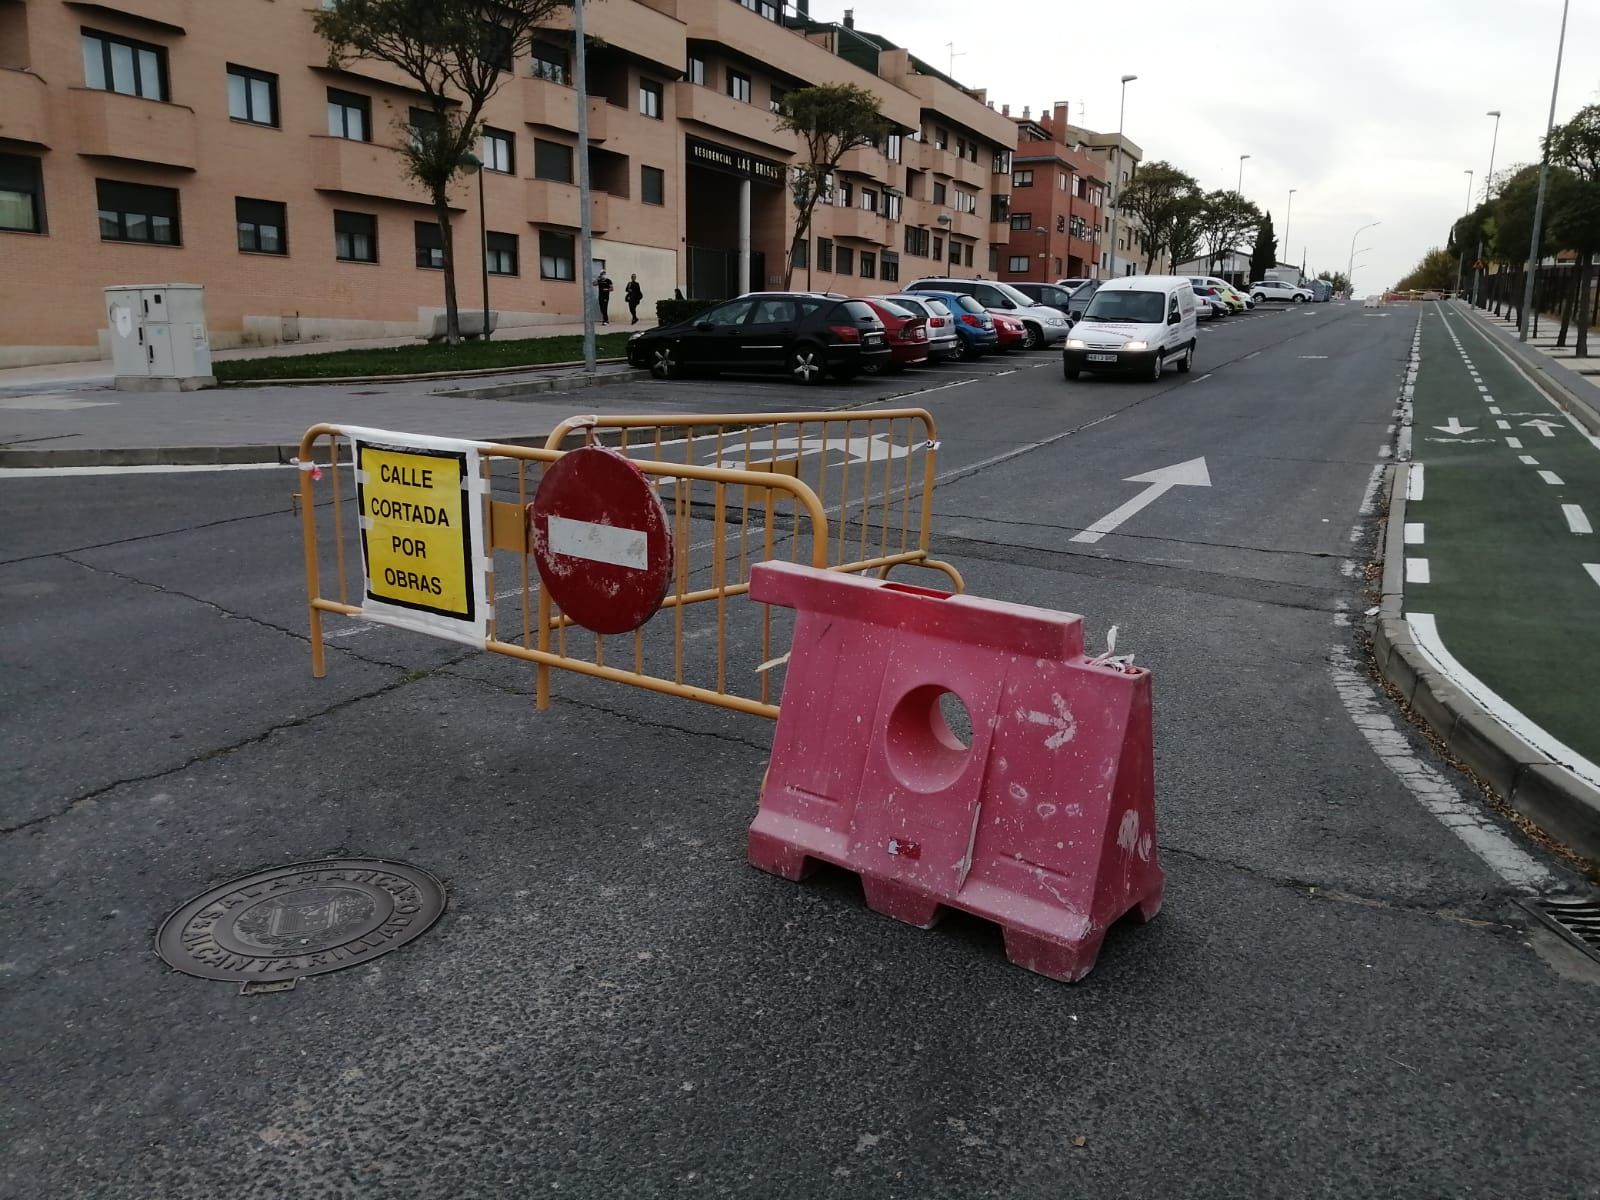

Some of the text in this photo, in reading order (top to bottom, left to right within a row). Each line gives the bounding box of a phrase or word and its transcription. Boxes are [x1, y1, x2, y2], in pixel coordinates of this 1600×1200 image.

[694, 146, 778, 179] RESIDENCIAL LAS BRISAS
[380, 463, 433, 489] CALLE
[371, 496, 450, 527] CORTADA
[392, 535, 427, 559] POR
[384, 567, 442, 596] OBRAS
[198, 870, 412, 920] SALAMANCA
[183, 902, 423, 973] ALCANTARILLADO
